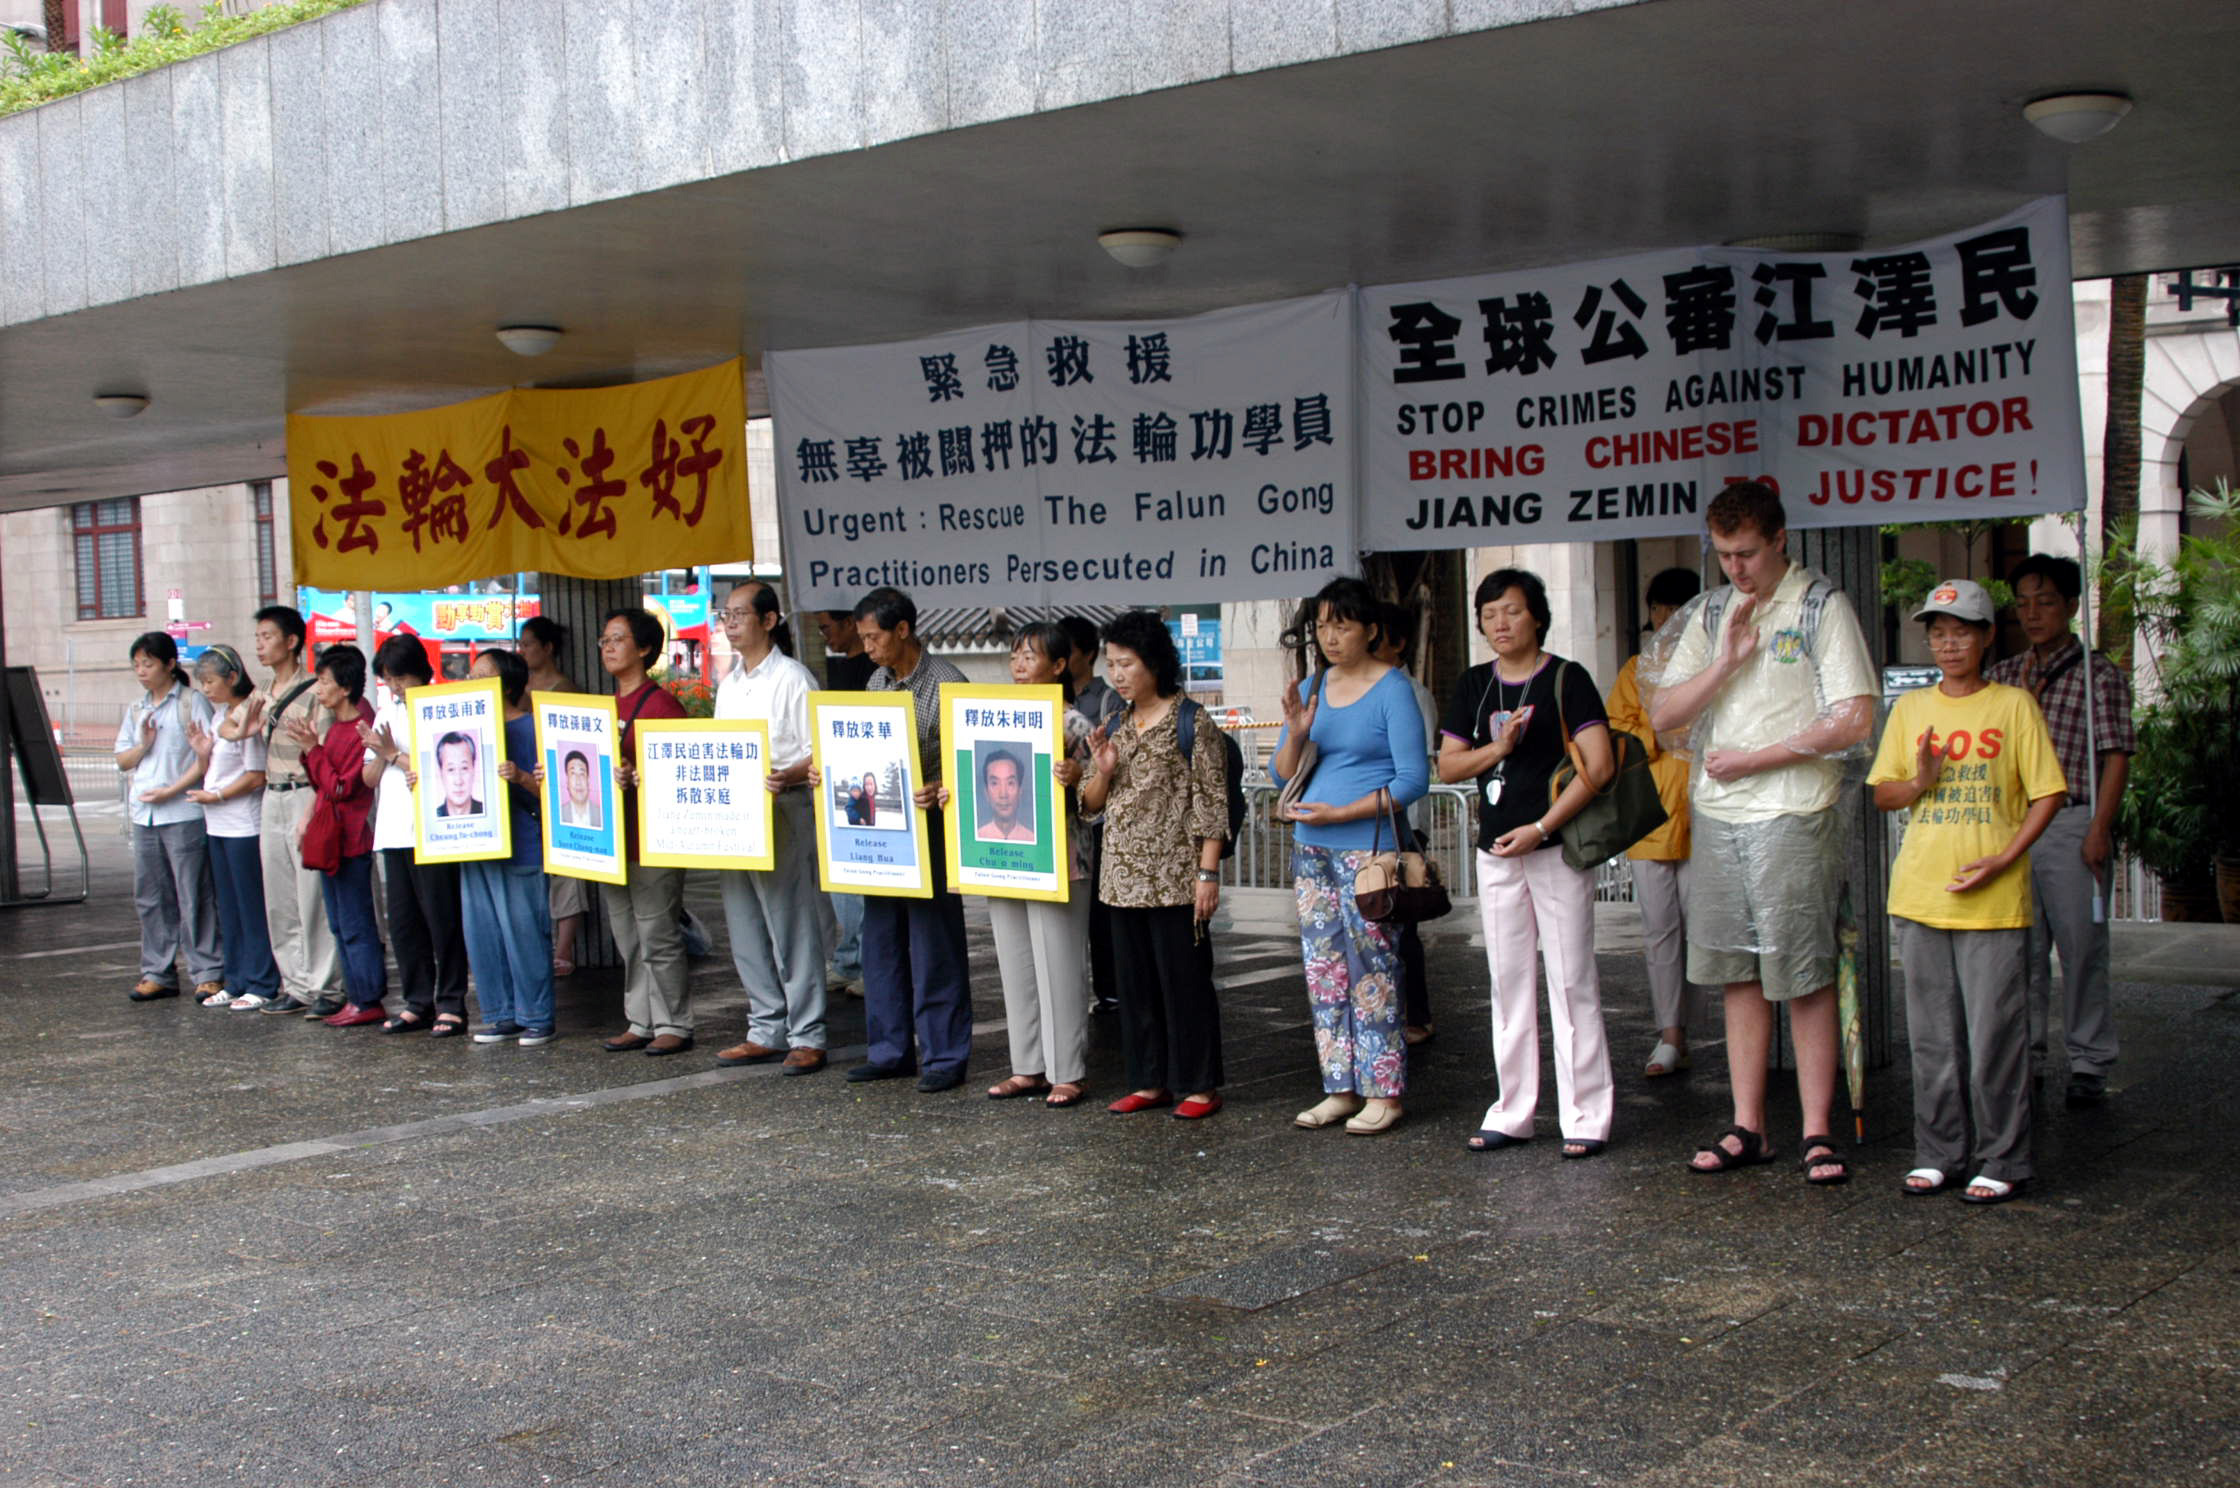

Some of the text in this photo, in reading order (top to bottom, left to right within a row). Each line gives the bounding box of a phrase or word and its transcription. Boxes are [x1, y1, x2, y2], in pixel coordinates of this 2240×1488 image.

[1388, 226, 2038, 384] 全球公審江澤民
[919, 332, 1172, 402] 緊急救援
[1397, 339, 2036, 435] STOP CRIMES AGAINST HUMANITY
[797, 393, 1334, 484] 無辜被關押的法輪功學員
[1409, 396, 2032, 480] BRING CHINESE DICTATOR
[311, 413, 723, 555] 法輪大法好
[804, 507, 906, 541] Urgent
[939, 504, 1024, 531] Rescue
[1045, 496, 1106, 524] The
[1135, 491, 1224, 521] Falun
[1258, 482, 1333, 514] Gong
[1406, 493, 1542, 530] JIANG
[1568, 481, 1696, 522] ZEMIN
[1809, 462, 2016, 505] JUSTICE
[810, 543, 1333, 588] Practitioners Persecuted in China
[964, 708, 1044, 730] 釋放朱柯明
[648, 742, 758, 760] 江澤民迫害法輪功
[675, 764, 730, 782] 非法關押
[1938, 763, 1988, 783] 急救援
[676, 787, 731, 805] 拆散家庭
